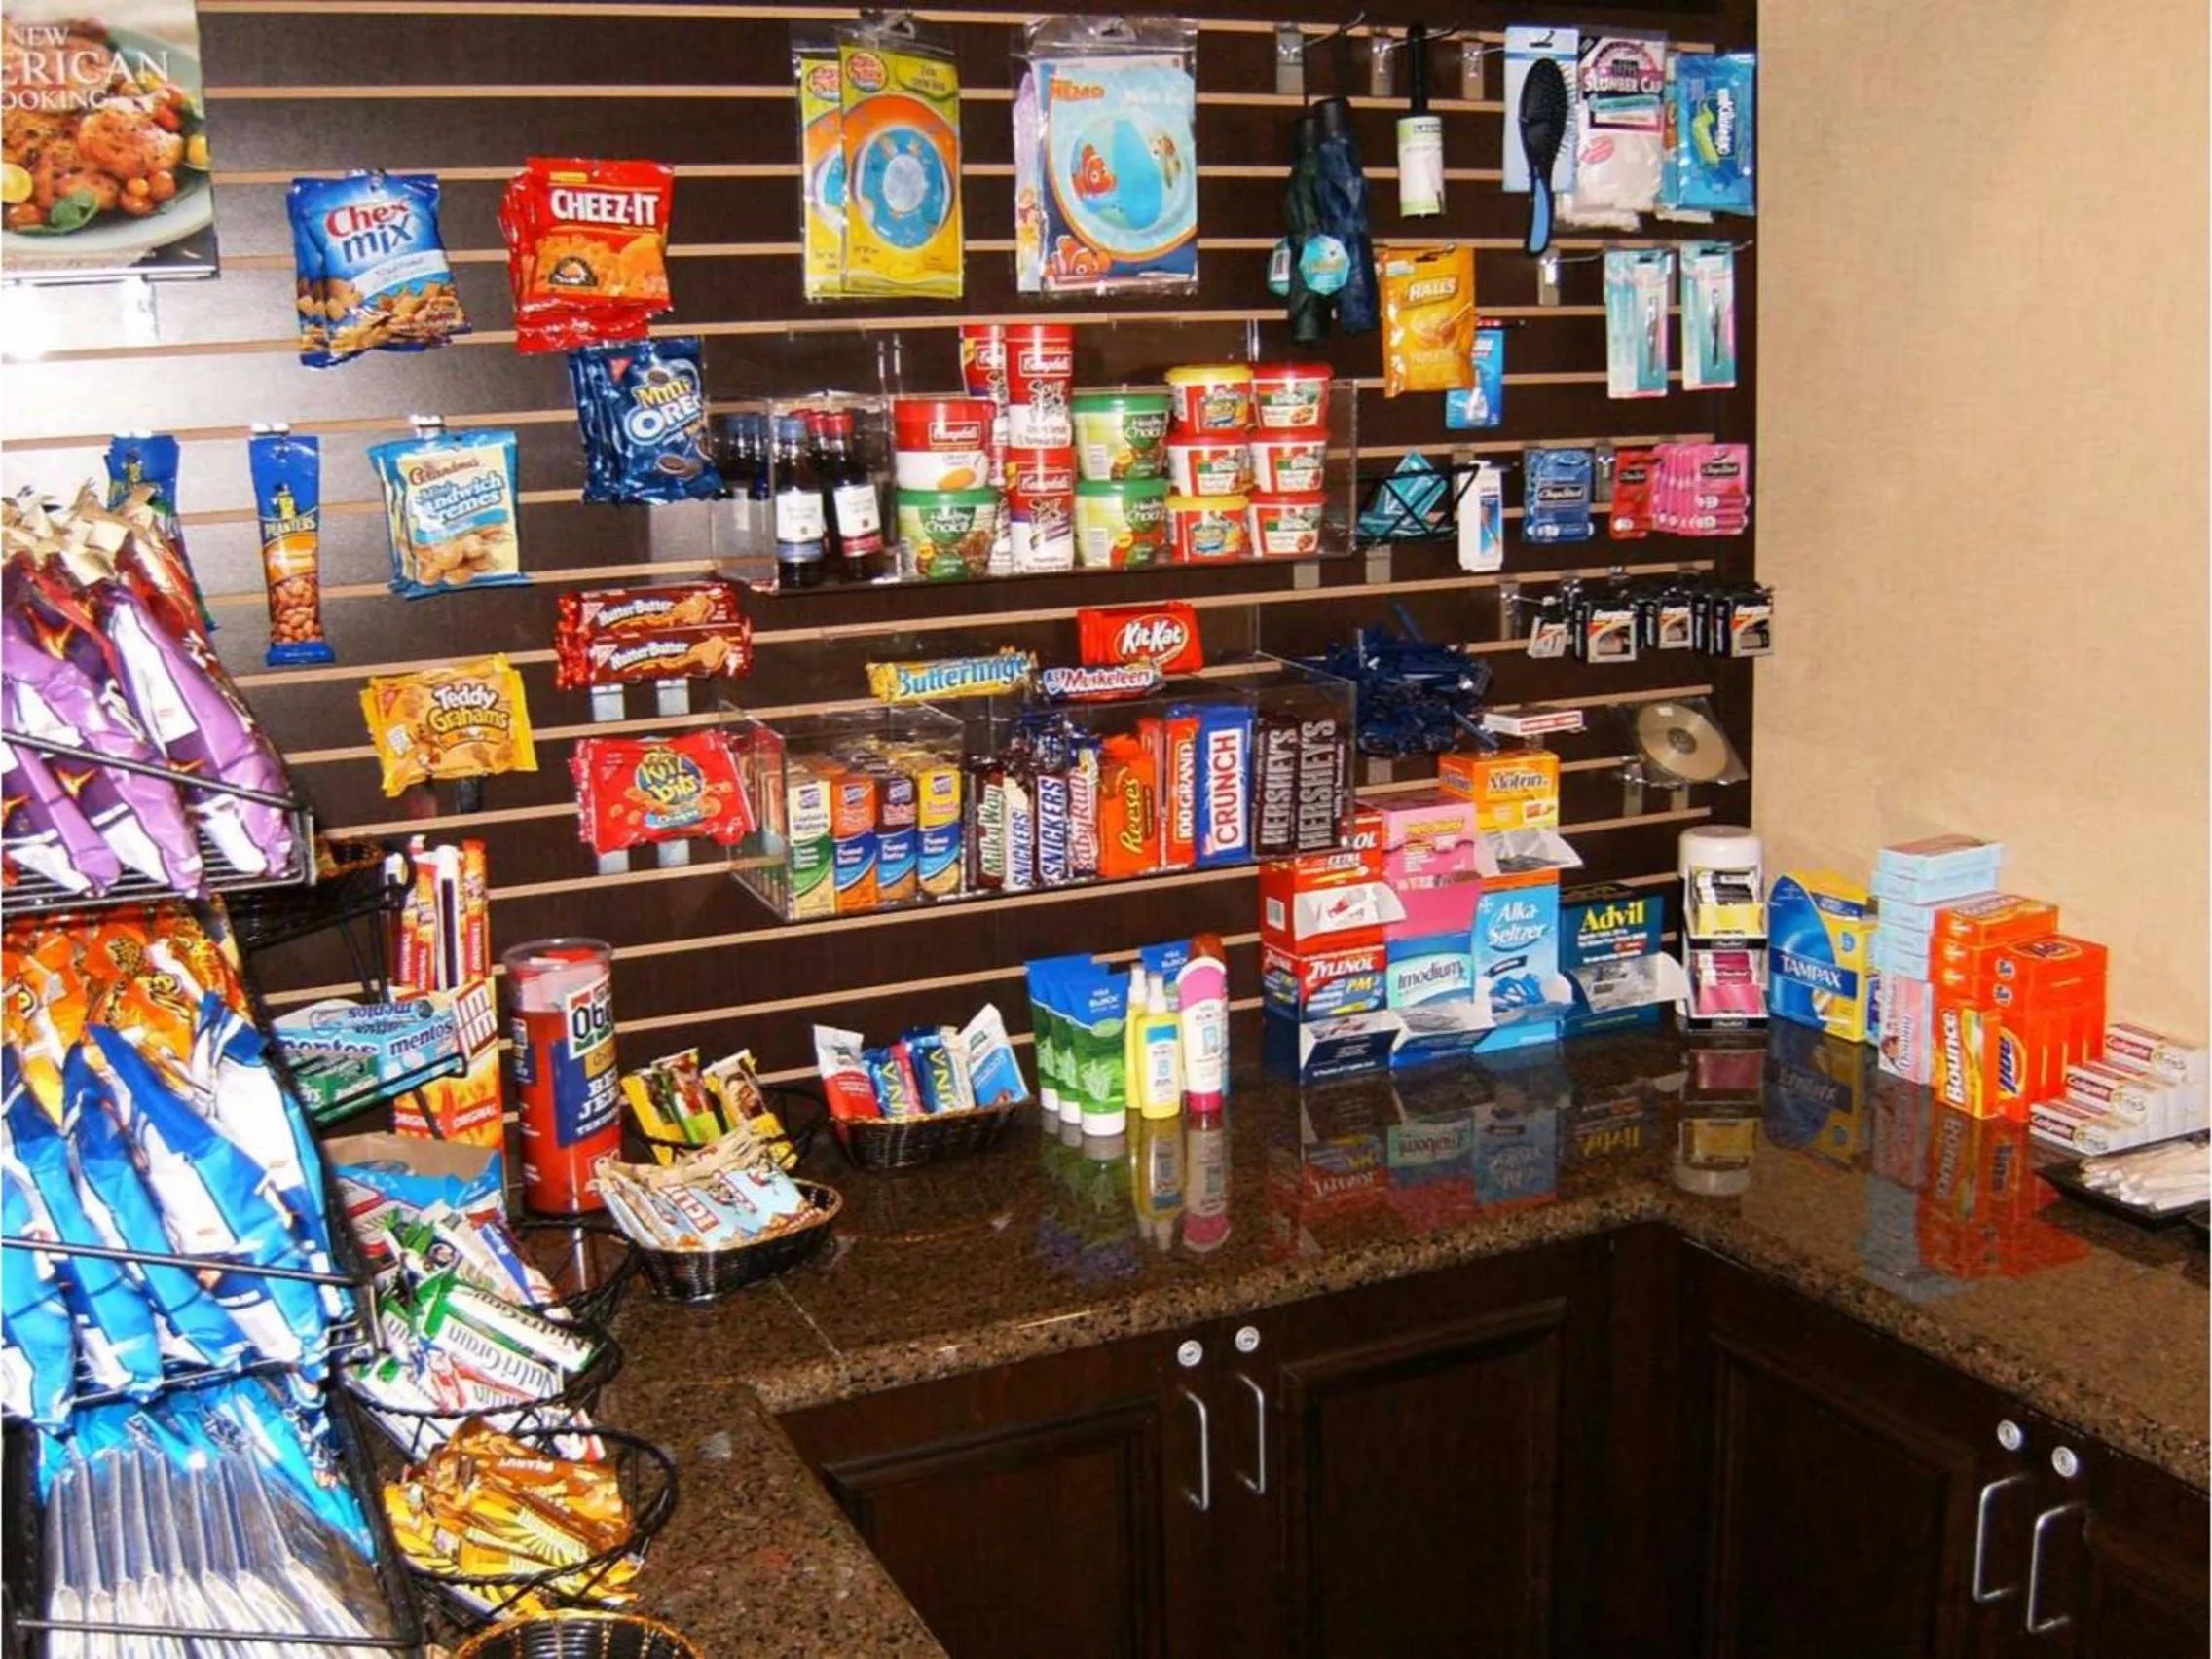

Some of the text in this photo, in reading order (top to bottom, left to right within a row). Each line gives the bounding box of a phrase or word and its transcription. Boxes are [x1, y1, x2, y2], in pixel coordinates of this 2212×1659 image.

[8, 26, 69, 47] NEW
[325, 199, 412, 240] Chex
[550, 188, 659, 226] CHEEZ-IT
[342, 214, 415, 264] mix
[1408, 277, 1456, 302] HALLS
[635, 378, 693, 408] Mini
[432, 682, 497, 710] Teddy
[427, 702, 511, 733] Grahams
[1178, 741, 1194, 807] GRAND
[1214, 735, 1238, 845] CRUNCH
[1261, 728, 1297, 845] HERSHEY'S
[1298, 719, 1336, 849] HERSHEY'S
[1040, 778, 1065, 881] SNICKERS
[1120, 778, 1143, 854] Reese's
[1013, 810, 1032, 886] SNICKERS
[1488, 924, 1545, 944] Seltzer
[1581, 901, 1645, 932] Advil
[1309, 956, 1377, 983] TYLENOL
[1398, 959, 1465, 990] Imodium
[1780, 954, 1842, 989] TAMPAX
[390, 1021, 453, 1055] mentos
[1942, 1010, 1966, 1104] Bounce
